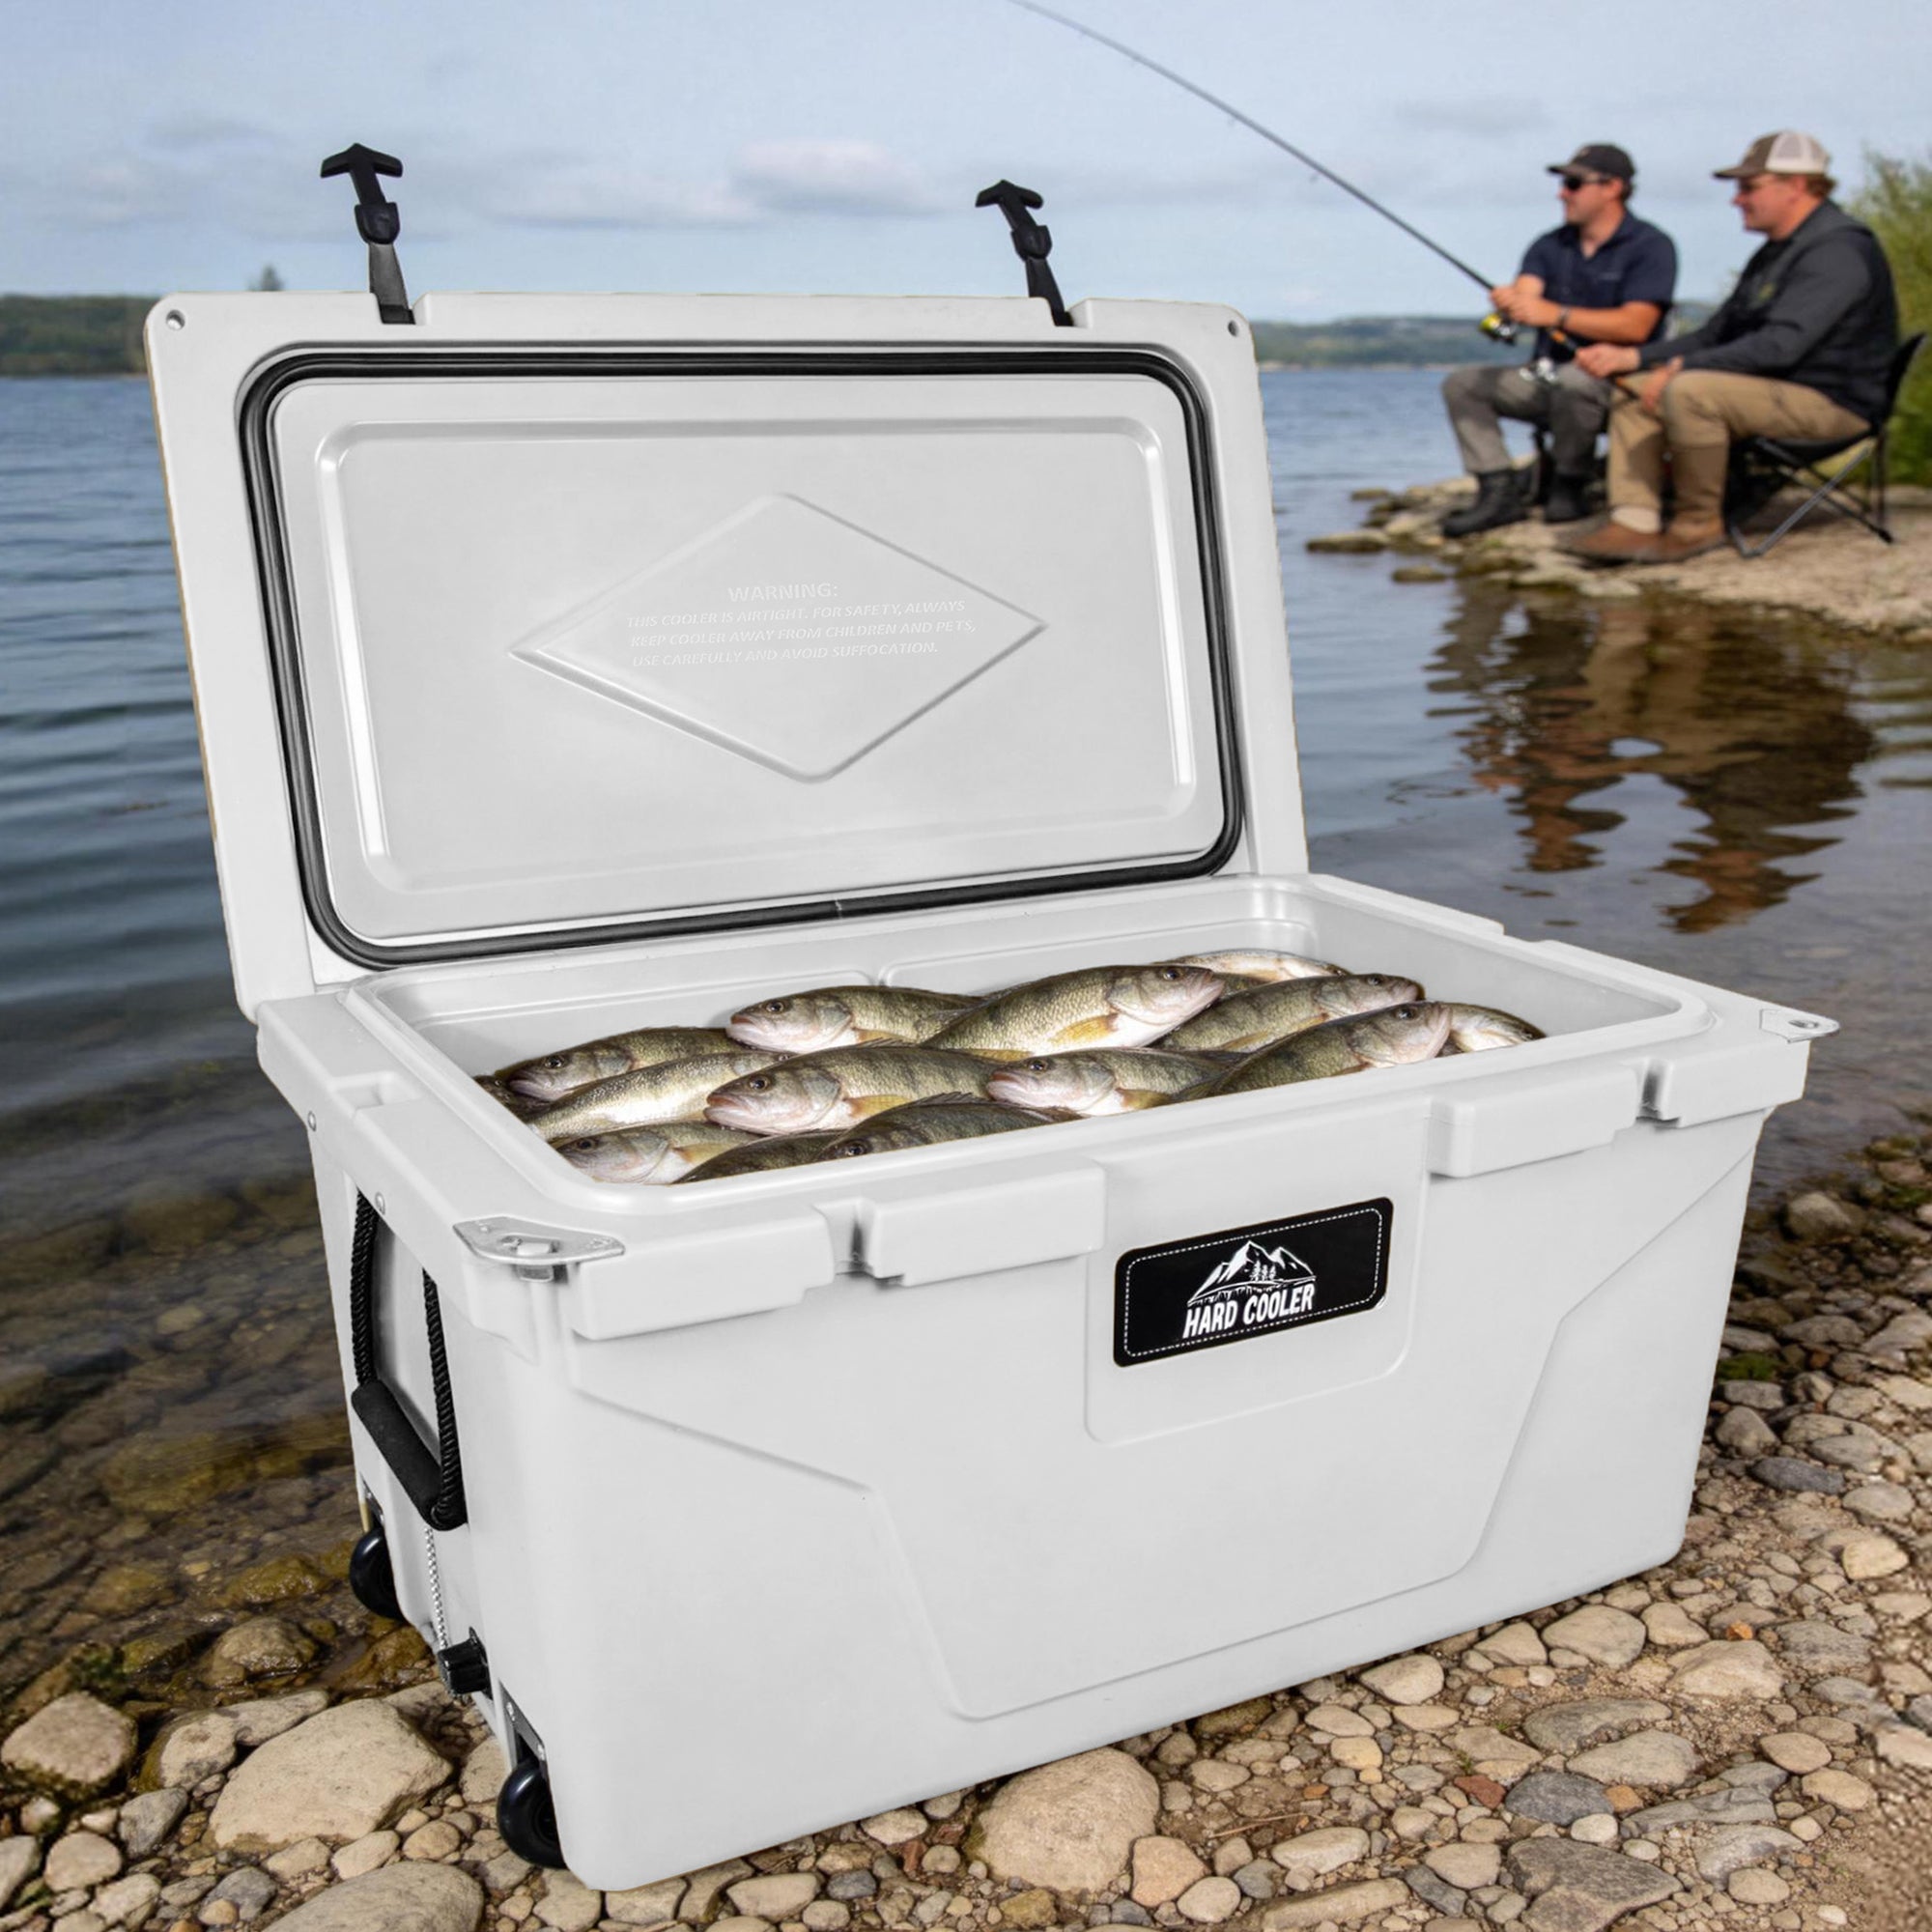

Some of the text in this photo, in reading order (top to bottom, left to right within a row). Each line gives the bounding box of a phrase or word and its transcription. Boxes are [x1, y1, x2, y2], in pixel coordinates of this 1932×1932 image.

[727, 582, 838, 602] WARNING:
[627, 600, 966, 628] THIS COOLER IS AIRTIGHT. FOR SAFETY, ALWAYS
[631, 619, 977, 647] KEEP COOLER AWAY FROM CHILDREN AND PETS,
[633, 641, 939, 667] USE CAREFULLY AND AVOID SUFFOCATION.
[1182, 1282, 1316, 1339] HARD COOLER
